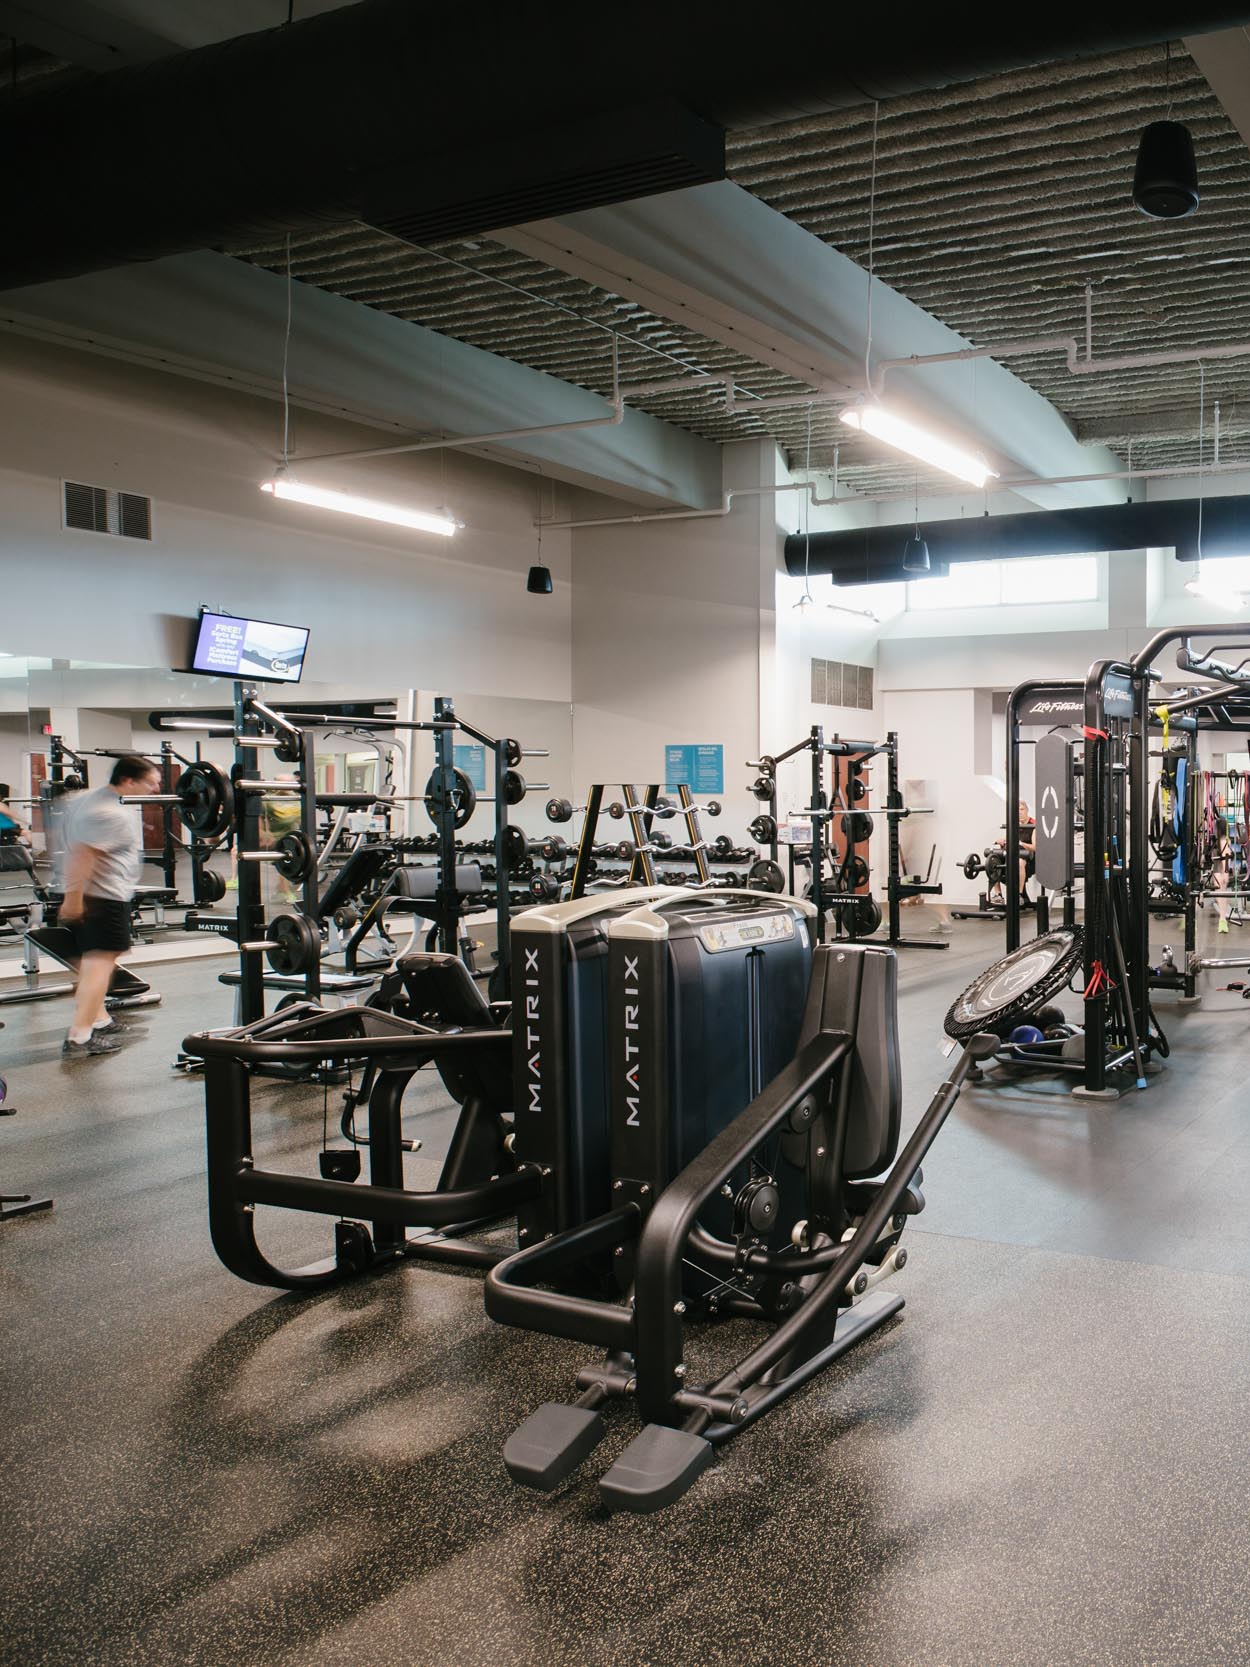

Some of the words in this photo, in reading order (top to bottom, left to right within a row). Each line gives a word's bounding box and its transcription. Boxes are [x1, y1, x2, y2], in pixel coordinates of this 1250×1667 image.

[198, 923, 229, 931] MATRIX
[525, 948, 542, 1112] MATRIX
[624, 955, 640, 1127] MATRIX
